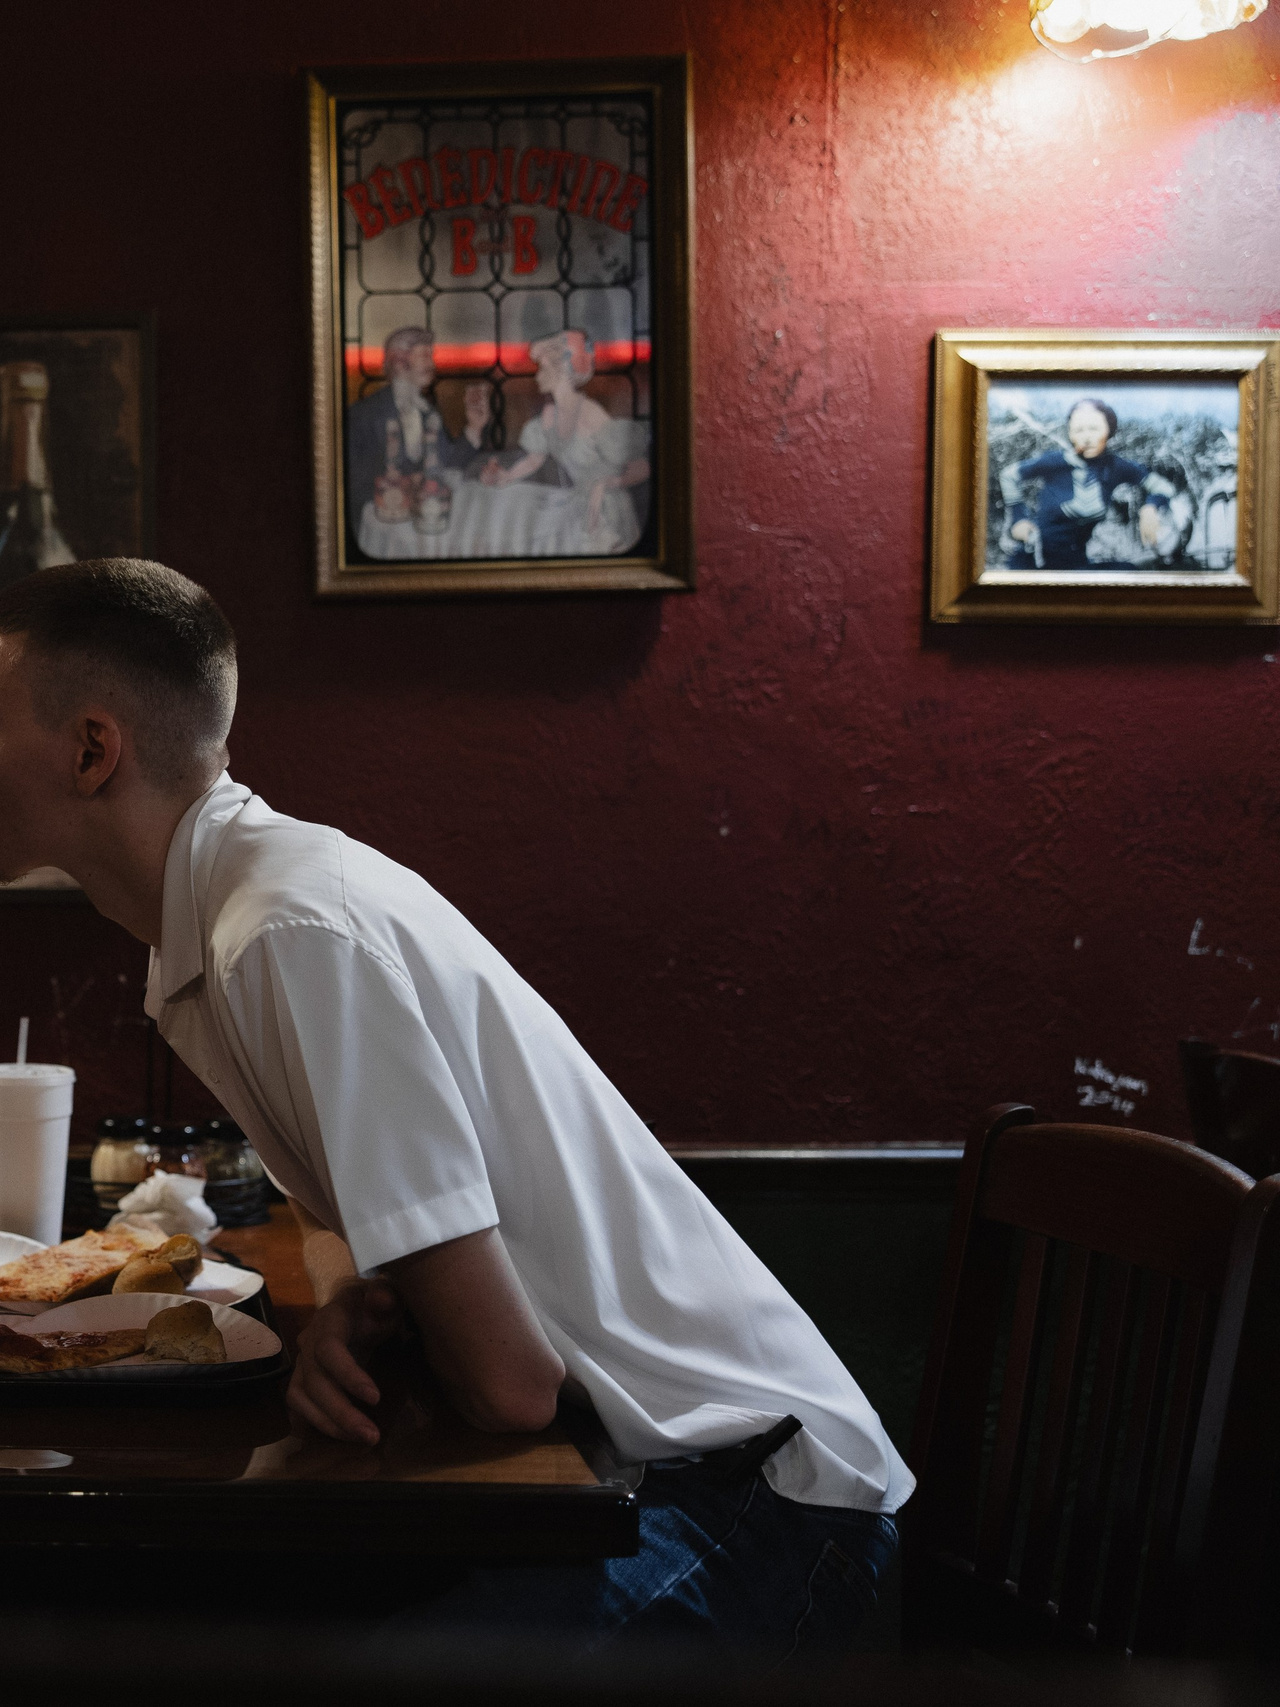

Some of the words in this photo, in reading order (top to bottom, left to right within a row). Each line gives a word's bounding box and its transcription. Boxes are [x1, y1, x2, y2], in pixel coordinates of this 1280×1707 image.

[343, 146, 648, 238] BENEDICTINE
[451, 218, 478, 275] B
[513, 215, 539, 274] B
